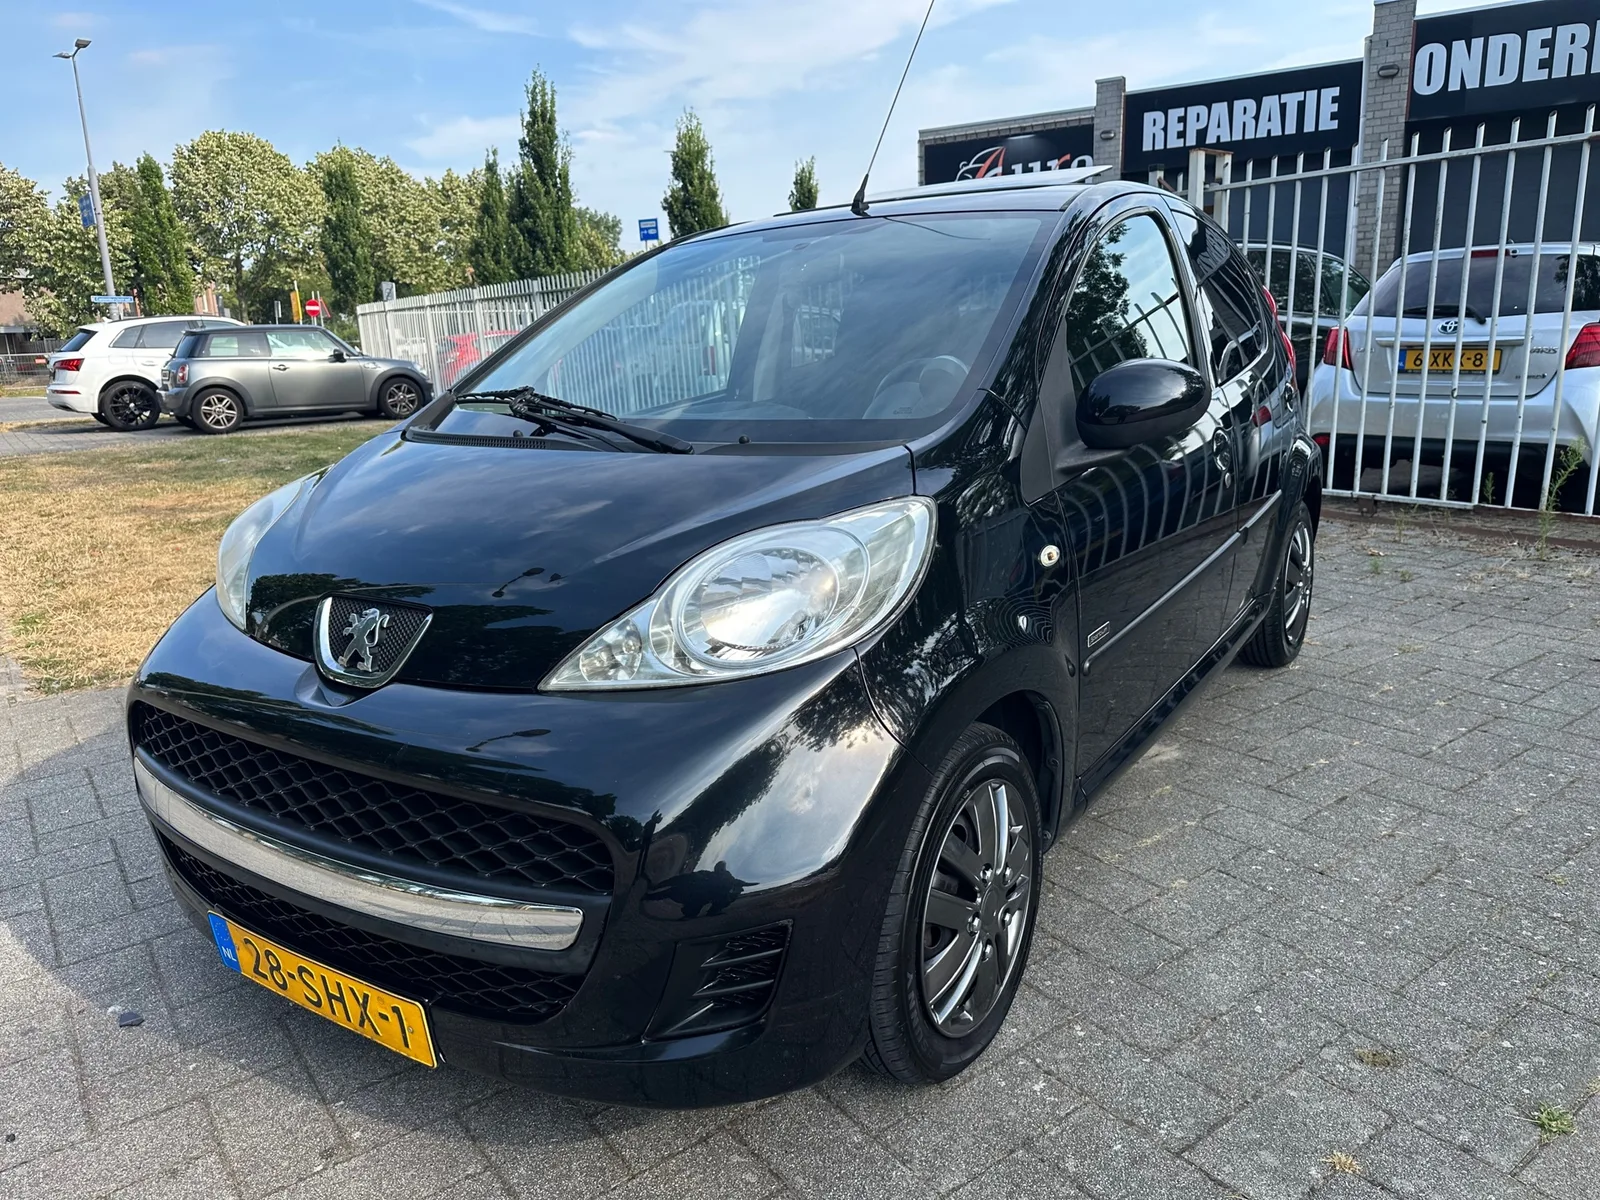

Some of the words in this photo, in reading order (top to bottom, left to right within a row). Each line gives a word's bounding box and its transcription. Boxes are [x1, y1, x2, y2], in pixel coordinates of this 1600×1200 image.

[1413, 20, 1600, 96] ONDER
[1142, 86, 1341, 152] REPARATIE
[1413, 352, 1484, 368] 6XKX-8
[221, 945, 237, 962] NL
[243, 936, 412, 1050] 28-SHX-1
